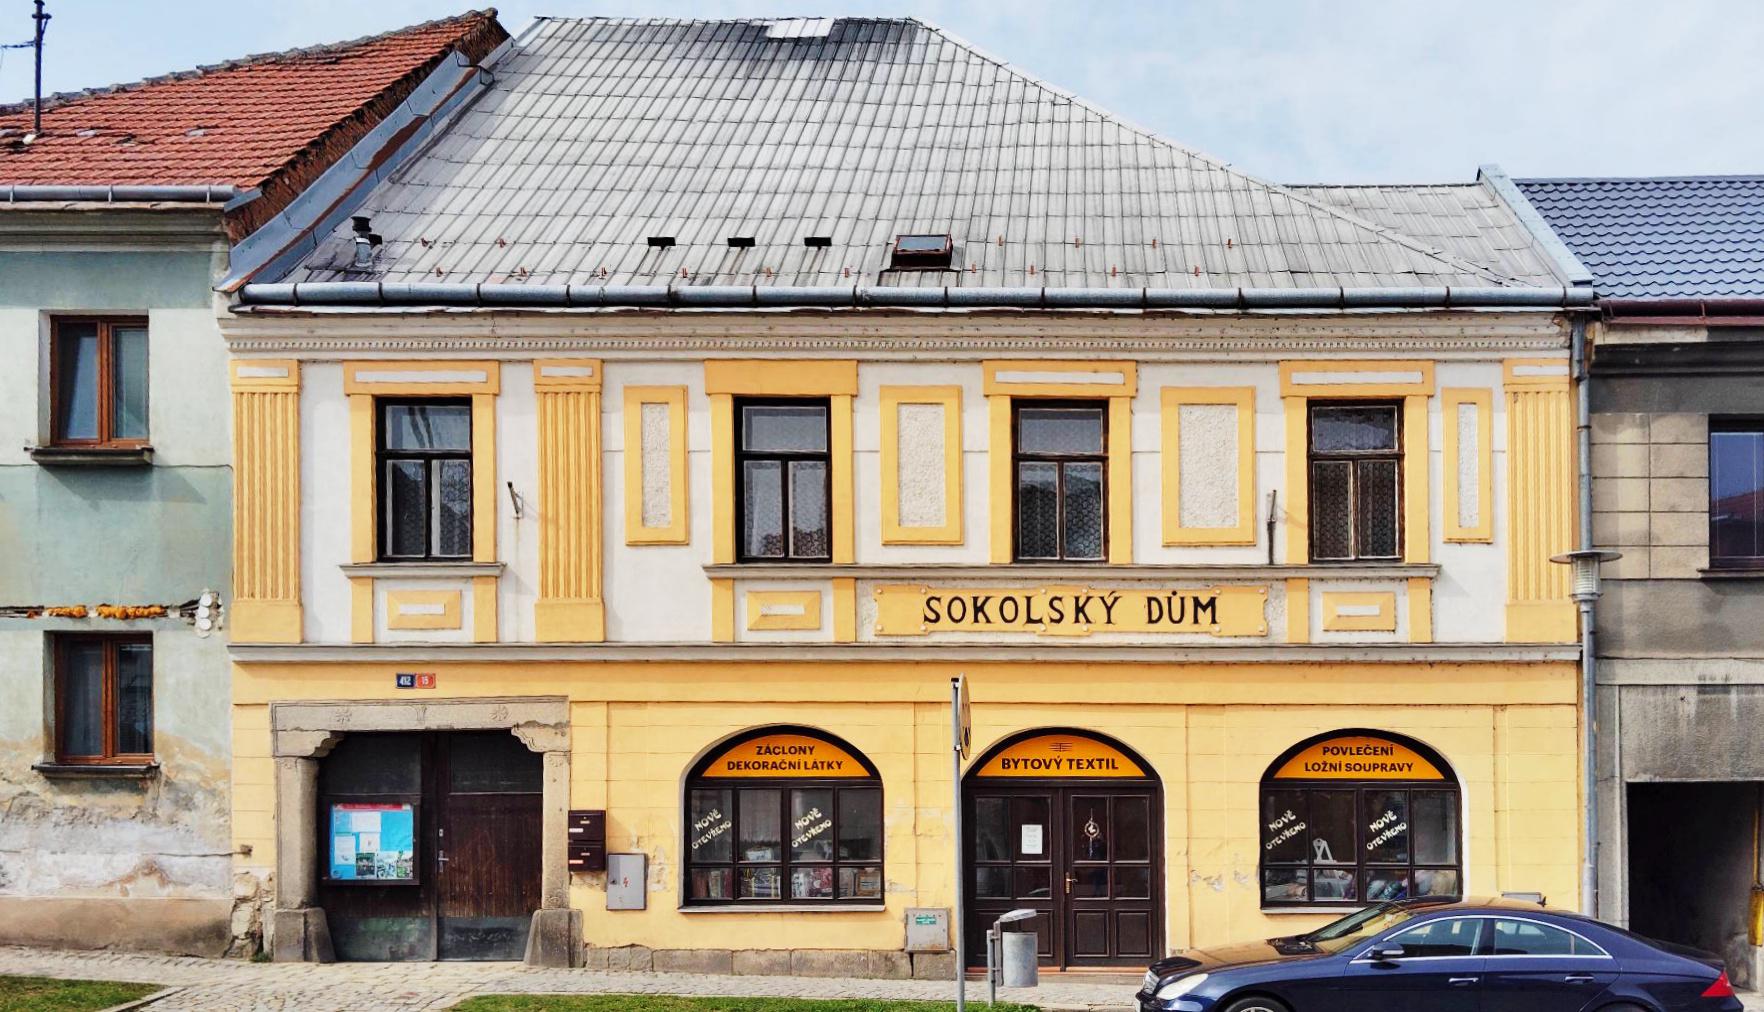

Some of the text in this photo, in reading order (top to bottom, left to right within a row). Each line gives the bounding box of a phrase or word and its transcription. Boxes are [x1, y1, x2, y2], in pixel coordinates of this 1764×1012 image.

[923, 590, 1218, 625] SOKOLSKÝ DŮM
[756, 744, 815, 755] ZÁCLONY
[1322, 744, 1394, 756] POVLEČENÍ
[727, 759, 843, 770] DEKORAČNÍ LÁTKY
[1001, 755, 1119, 769] BYTOVÝ TEXTIL
[1304, 760, 1413, 772] LOŽNÍ SOUPRAVY
